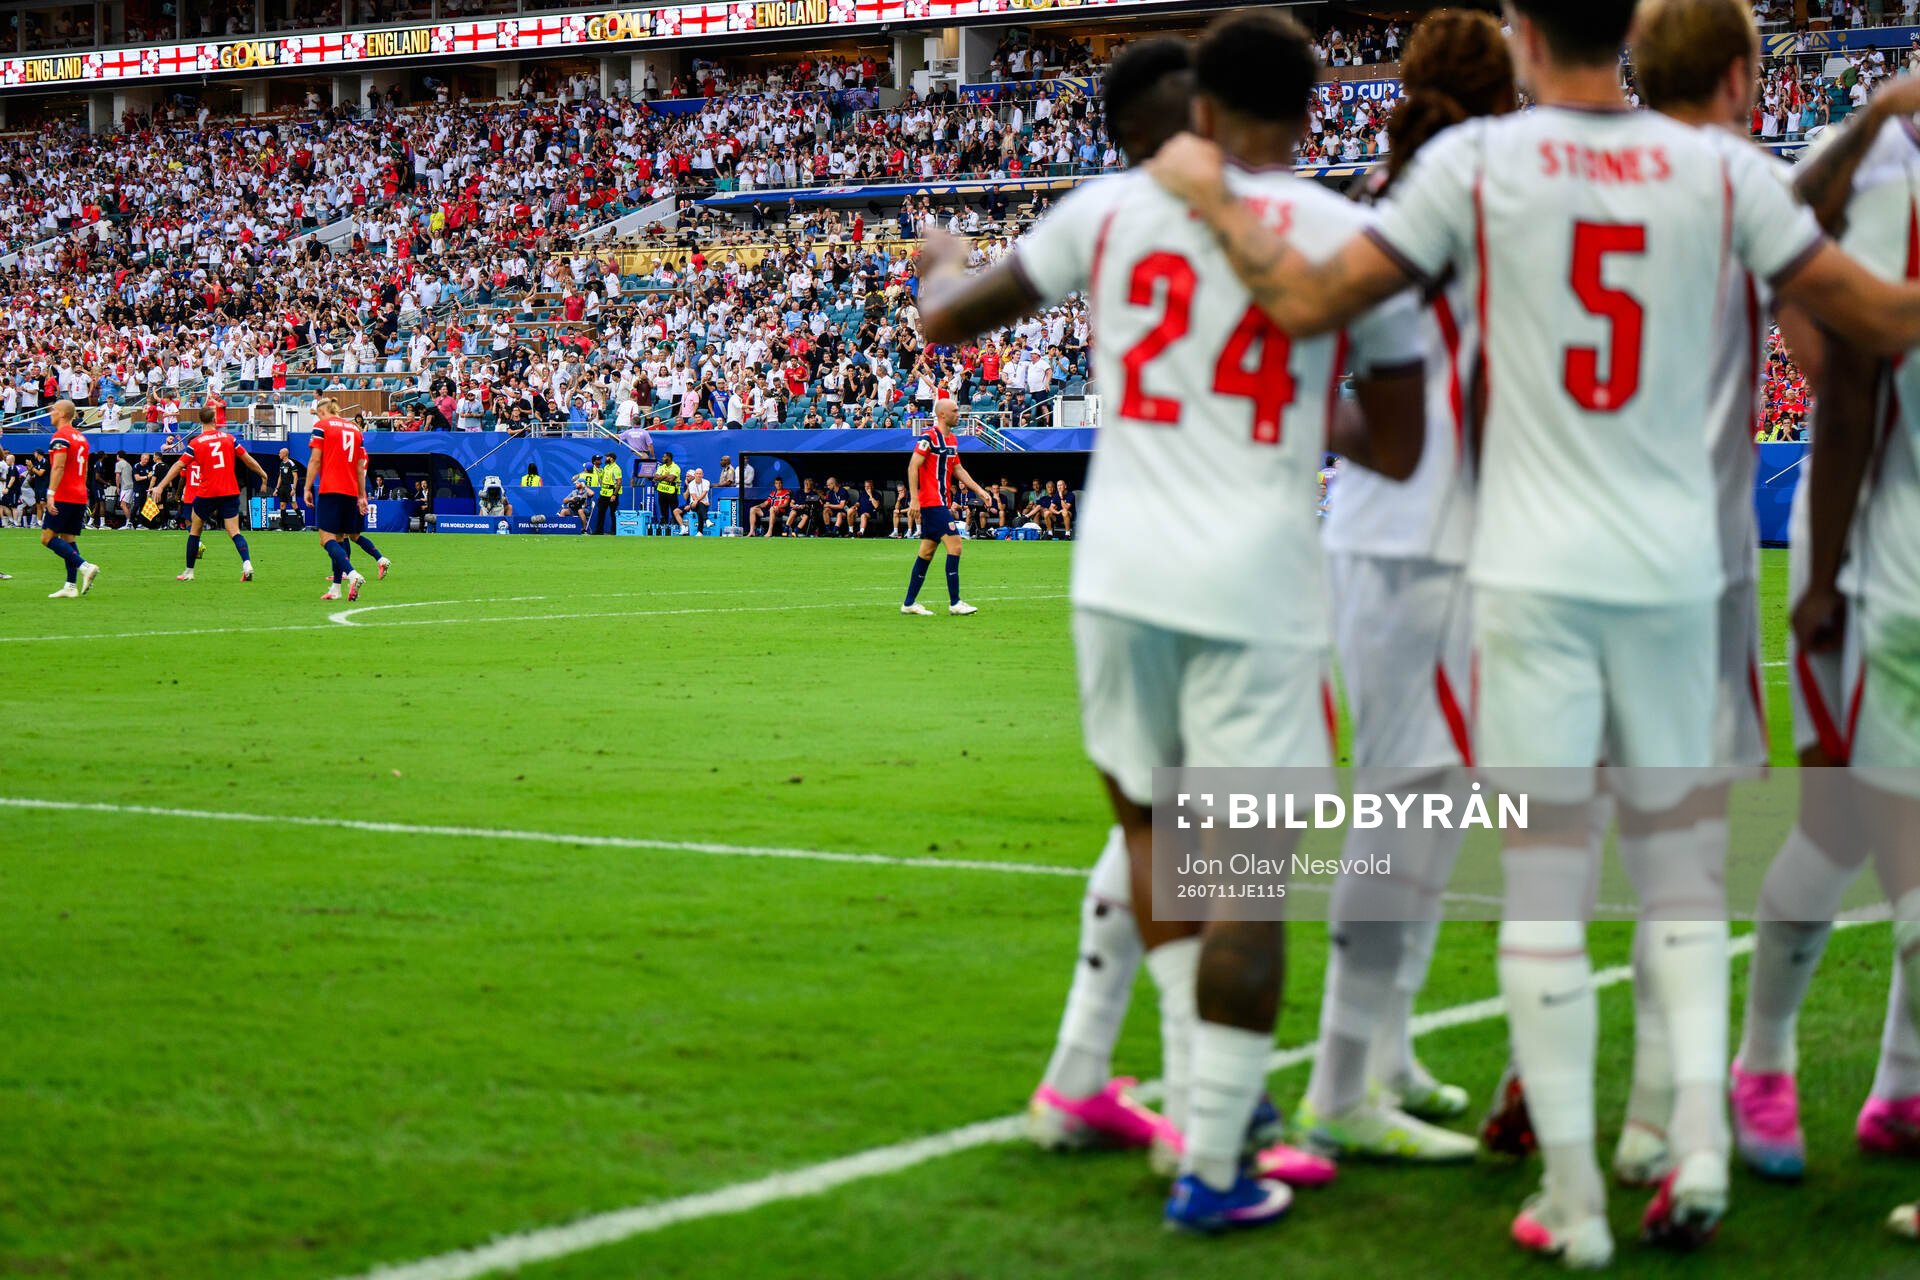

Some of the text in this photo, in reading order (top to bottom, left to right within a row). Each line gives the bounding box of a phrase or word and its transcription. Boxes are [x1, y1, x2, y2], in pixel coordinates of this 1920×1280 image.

[587, 11, 650, 41] GOAL!
[756, 0, 829, 28] ENGLAND
[220, 42, 276, 69] GOAL!
[366, 29, 430, 56] ENGLAND
[25, 57, 82, 82] ENGLAND
[1358, 82, 1396, 101] CUP
[1539, 139, 1672, 184] STONES
[1563, 219, 1646, 413] 5
[1119, 250, 1296, 444] 24
[209, 441, 225, 469] 3
[342, 430, 355, 463] 9
